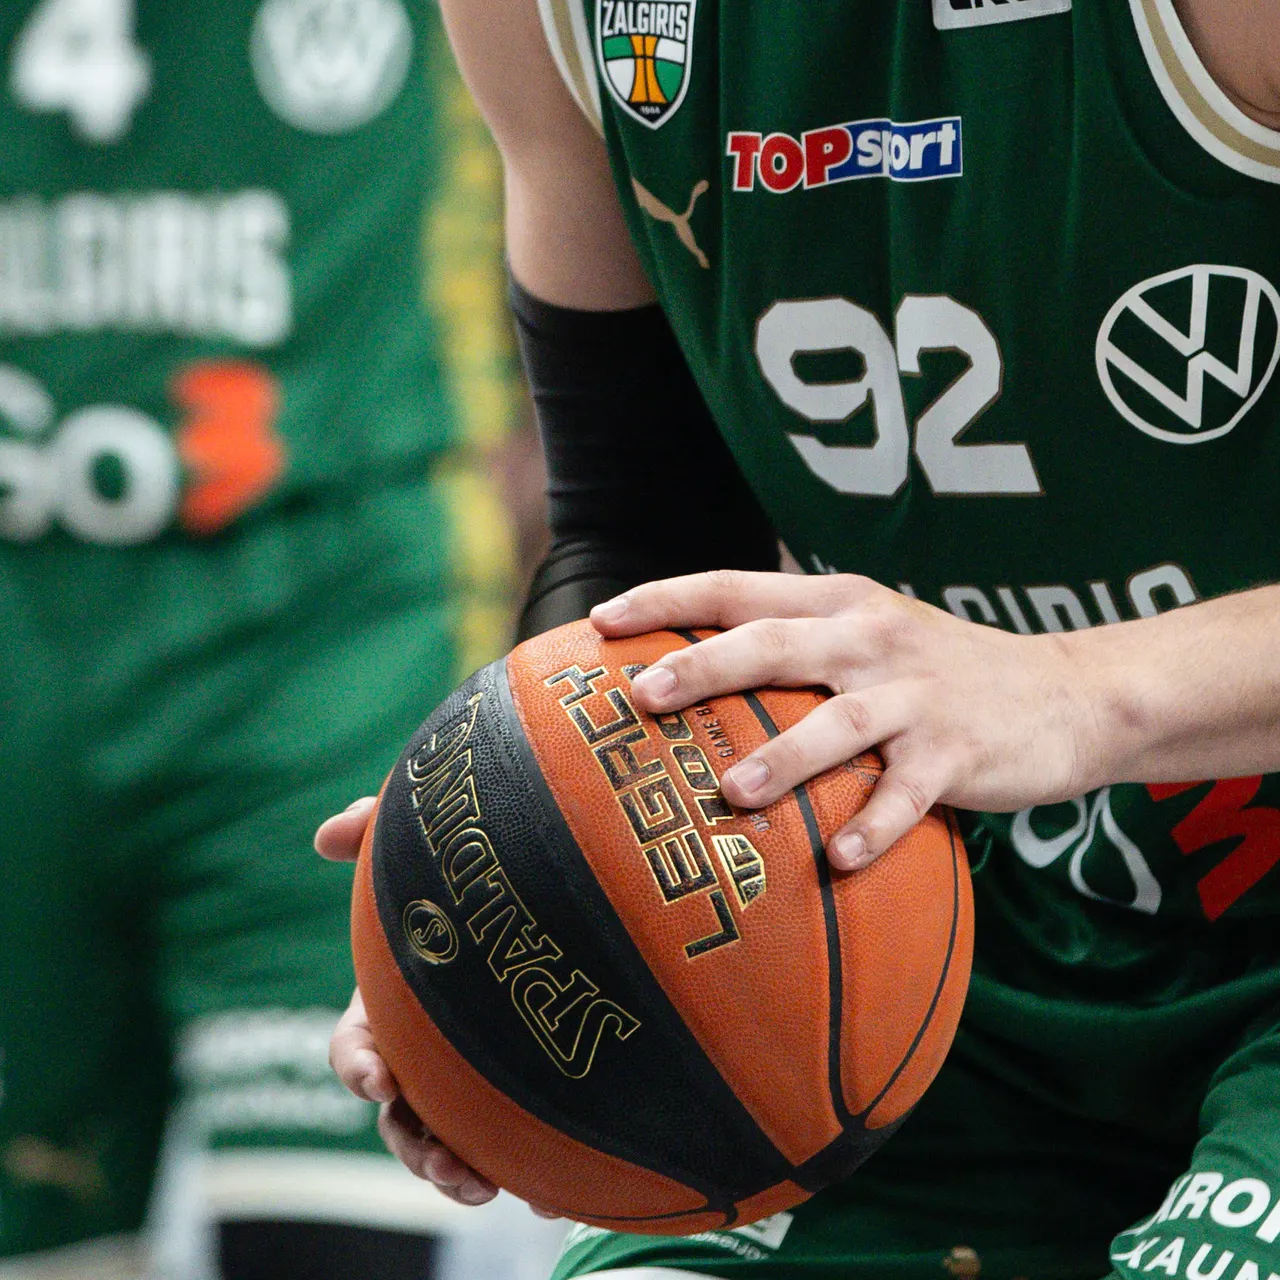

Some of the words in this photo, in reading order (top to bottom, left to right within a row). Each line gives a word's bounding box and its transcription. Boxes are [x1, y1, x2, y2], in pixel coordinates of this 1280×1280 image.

[726, 117, 963, 193] TOPsport
[754, 293, 1045, 498] 92
[544, 664, 742, 961] LEGACY
[702, 718, 736, 758] GAME
[406, 692, 642, 1080] SPALDING
